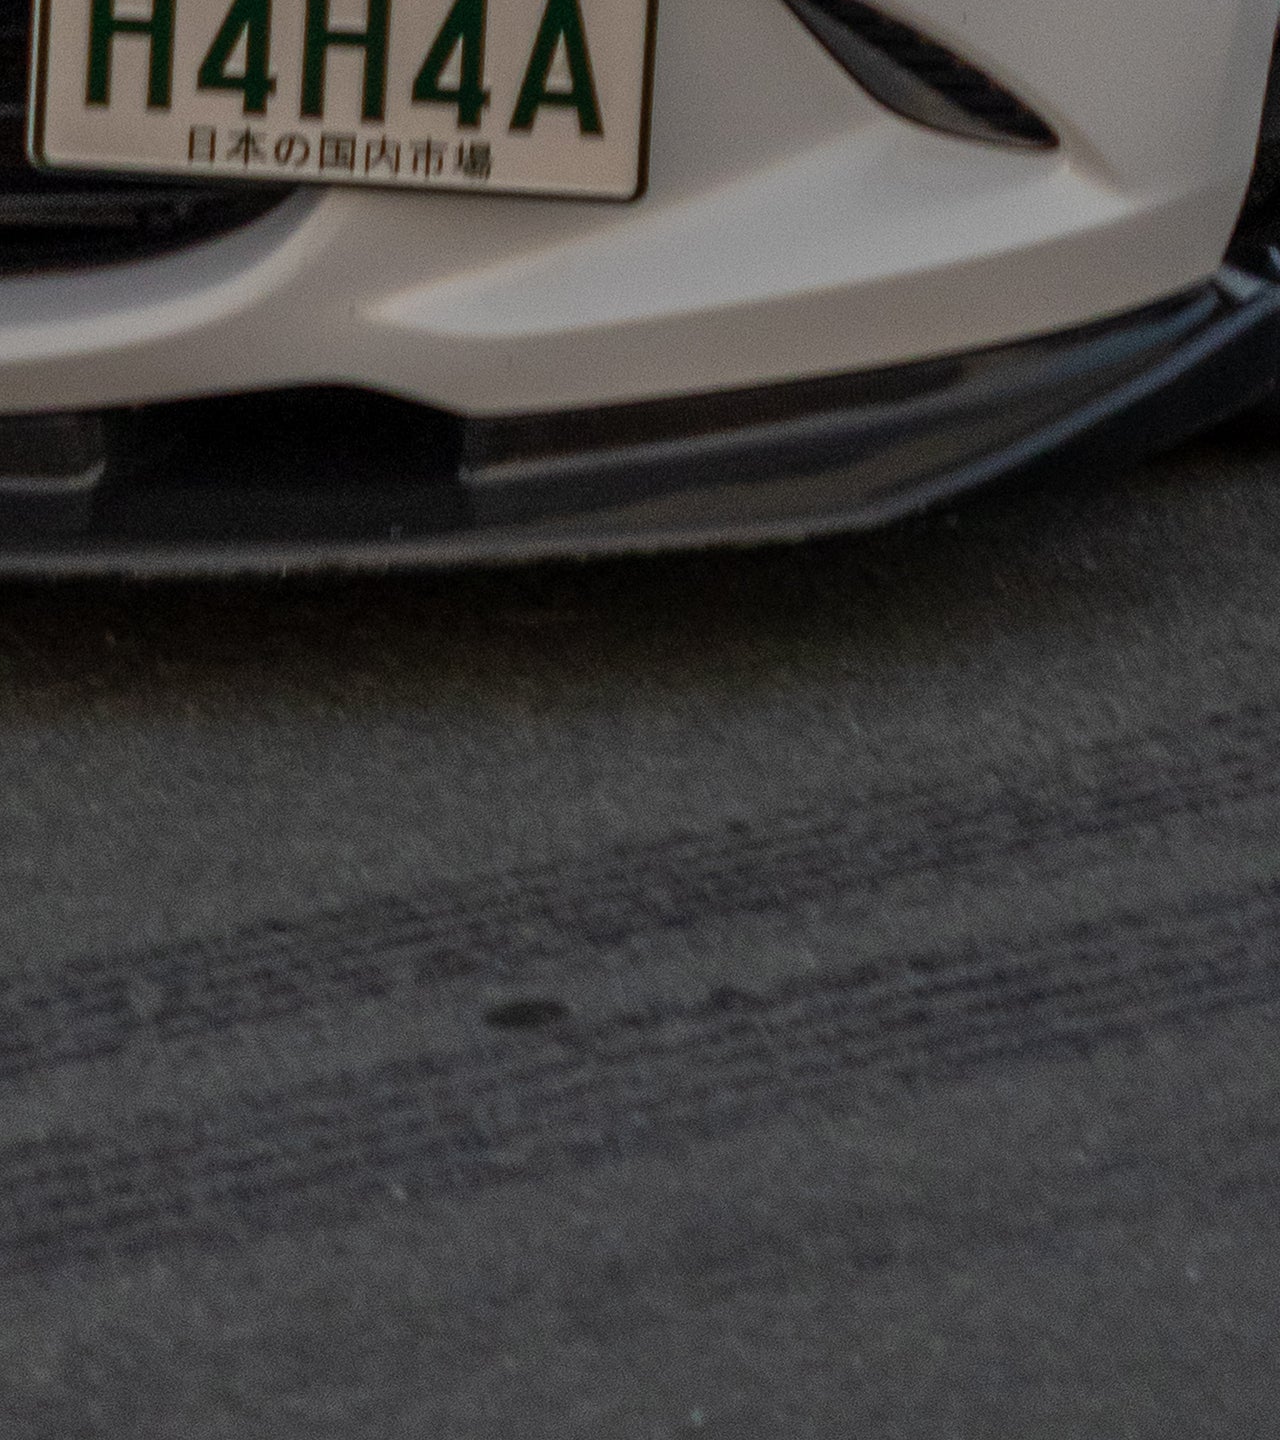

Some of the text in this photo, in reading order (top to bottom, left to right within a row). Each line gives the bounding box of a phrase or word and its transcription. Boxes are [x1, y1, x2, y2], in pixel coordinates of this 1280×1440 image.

[187, 125, 492, 180] 日本の国内市場
